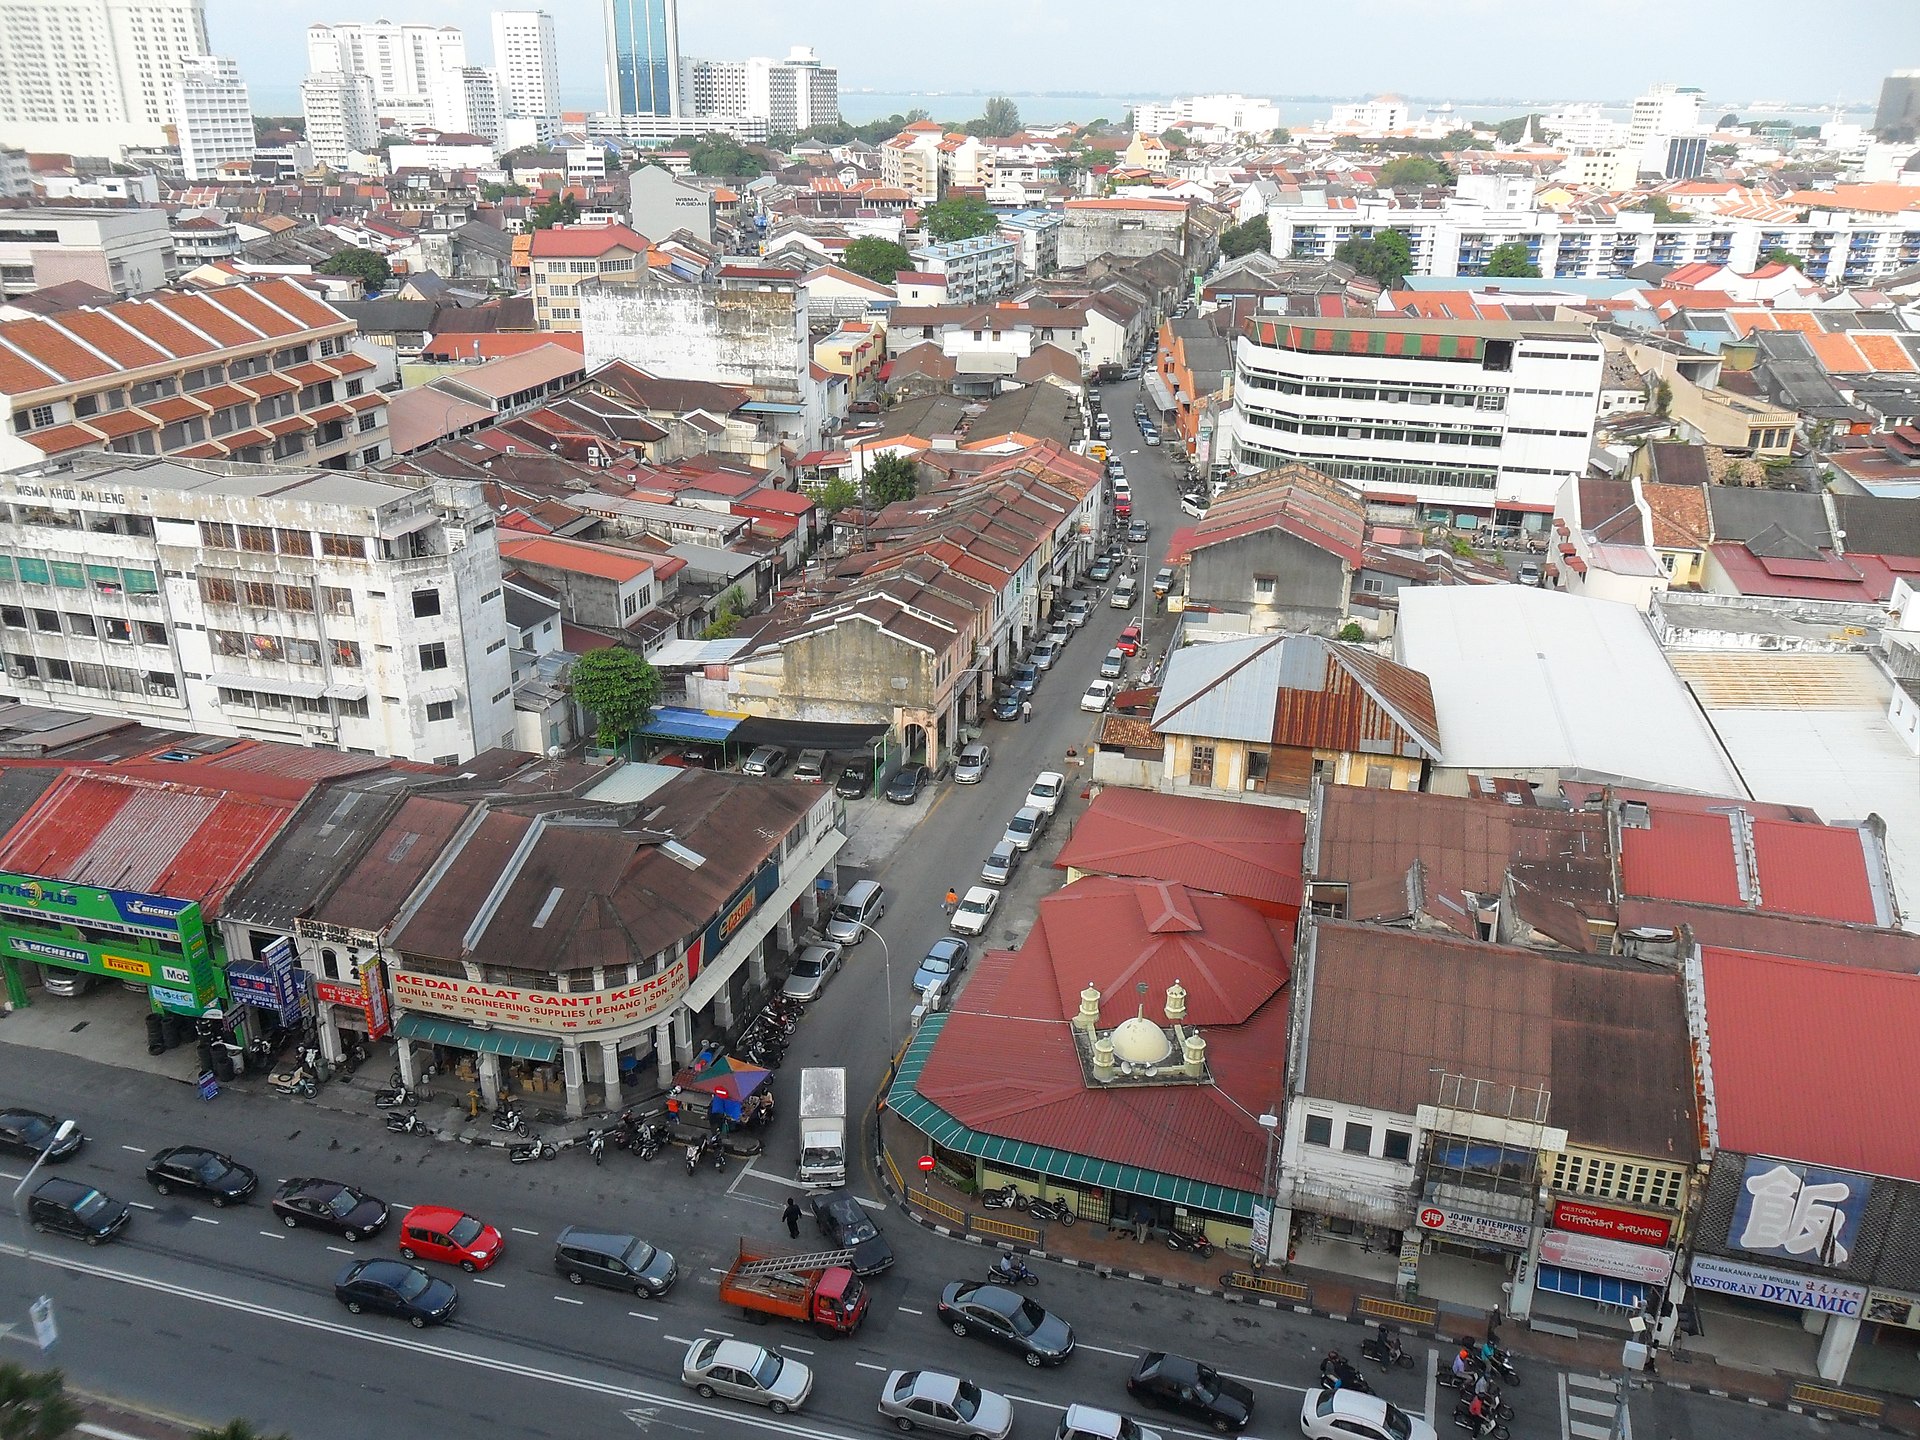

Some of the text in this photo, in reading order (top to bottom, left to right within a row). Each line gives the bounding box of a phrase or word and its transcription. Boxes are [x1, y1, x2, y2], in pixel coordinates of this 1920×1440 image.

[14, 484, 125, 505] WISMA KHOO AH LENG
[728, 892, 753, 931] Castrol
[301, 929, 324, 941] HOCK
[30, 943, 85, 960] MICHELIN
[108, 958, 145, 973] PIRELLI
[395, 961, 685, 1007] KEDAI ALAT GANTI KERETA
[397, 986, 427, 998] DUNIA
[430, 991, 458, 1003] EMAS
[460, 996, 531, 1013] ENGINEERING
[533, 1007, 586, 1018] SUPPLIES
[596, 1000, 641, 1015] PENANG
[650, 988, 670, 1001] SDN.
[671, 974, 686, 989] BHD.
[1423, 1211, 1442, 1225] 押
[1561, 1205, 1597, 1216] RESTORAN
[1740, 1165, 1850, 1267] 飯
[1448, 1212, 1529, 1234] JOJIN ENTERPRISE
[1560, 1213, 1663, 1239] CITARASA SAYANG
[1696, 1262, 1801, 1288] KEDAI MAKANAN DAN MINUMAN
[1694, 1275, 1858, 1315] RESTORAN DYNAMIC
